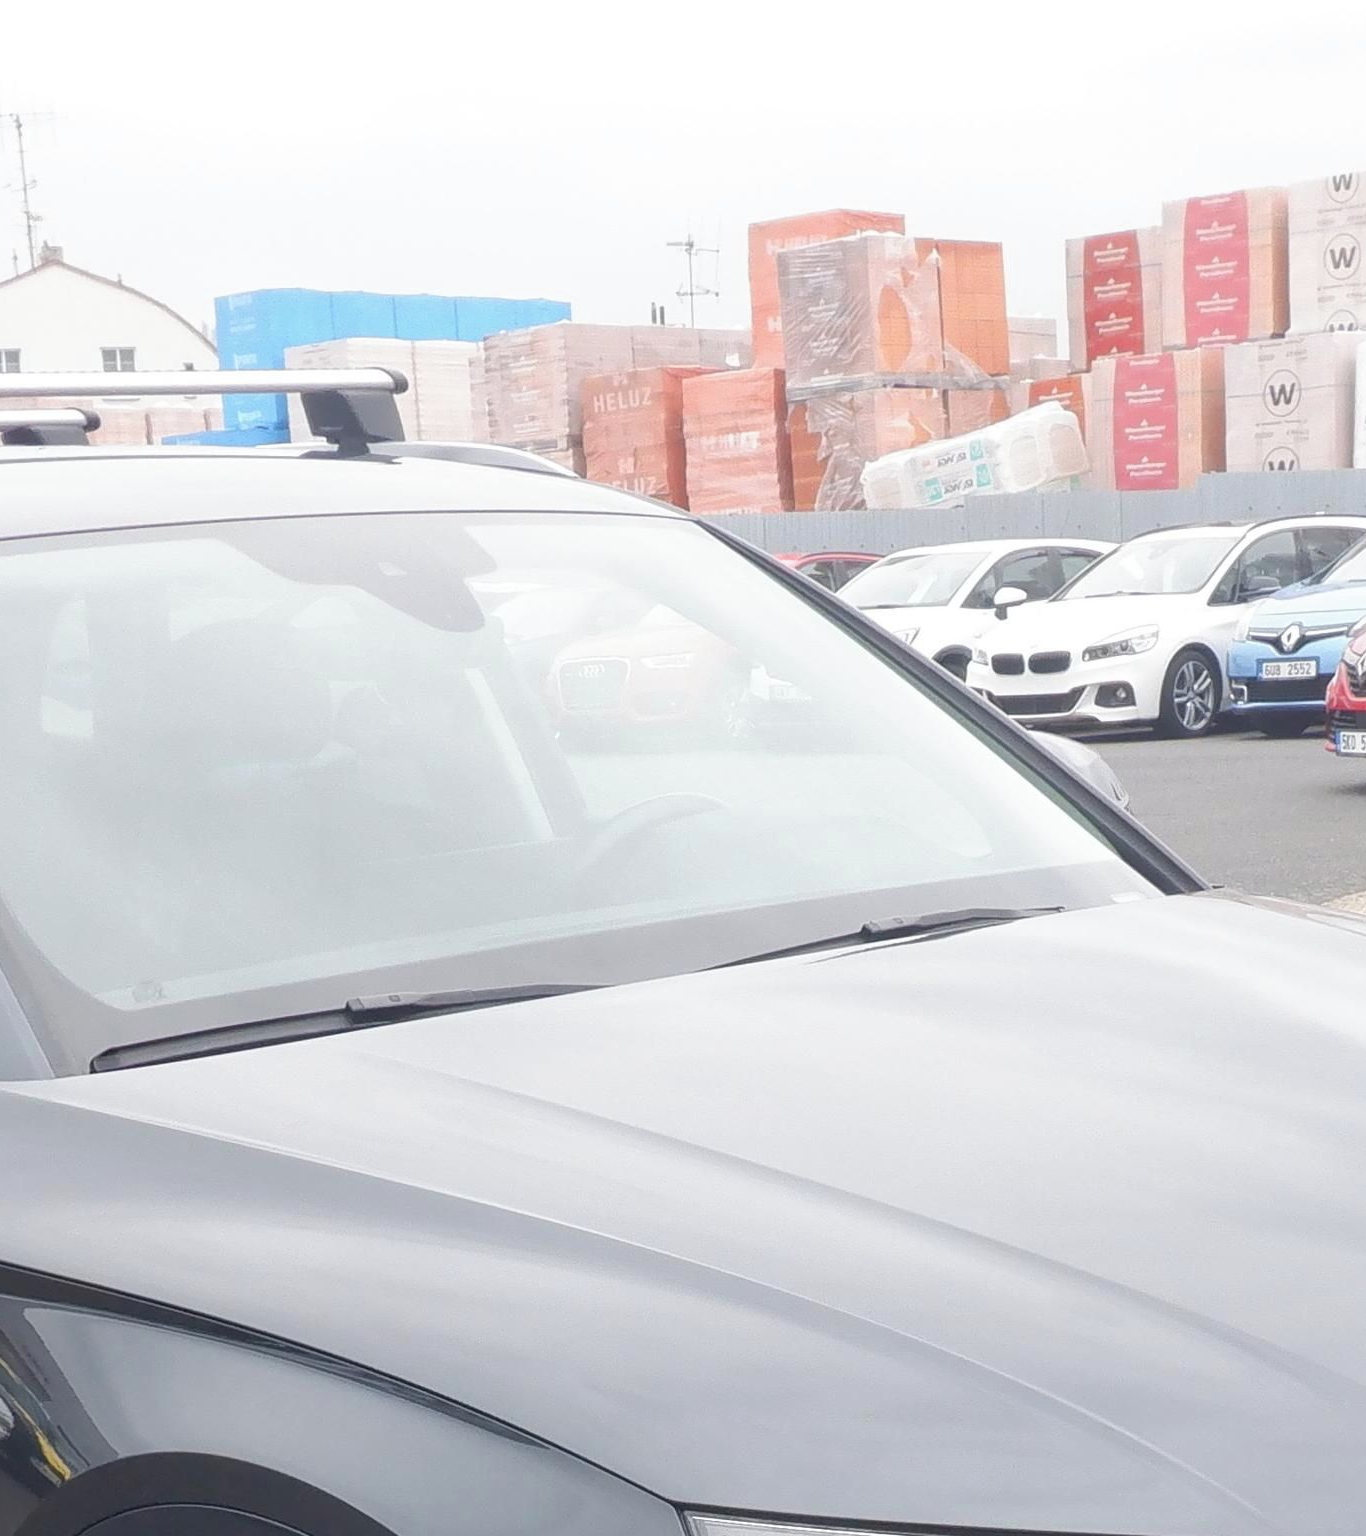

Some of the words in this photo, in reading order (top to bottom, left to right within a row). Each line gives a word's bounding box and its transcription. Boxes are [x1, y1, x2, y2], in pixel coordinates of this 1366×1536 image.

[1329, 246, 1356, 270] W
[593, 387, 653, 413] HELUZ
[1269, 383, 1296, 406] W
[1287, 662, 1312, 676] 2552
